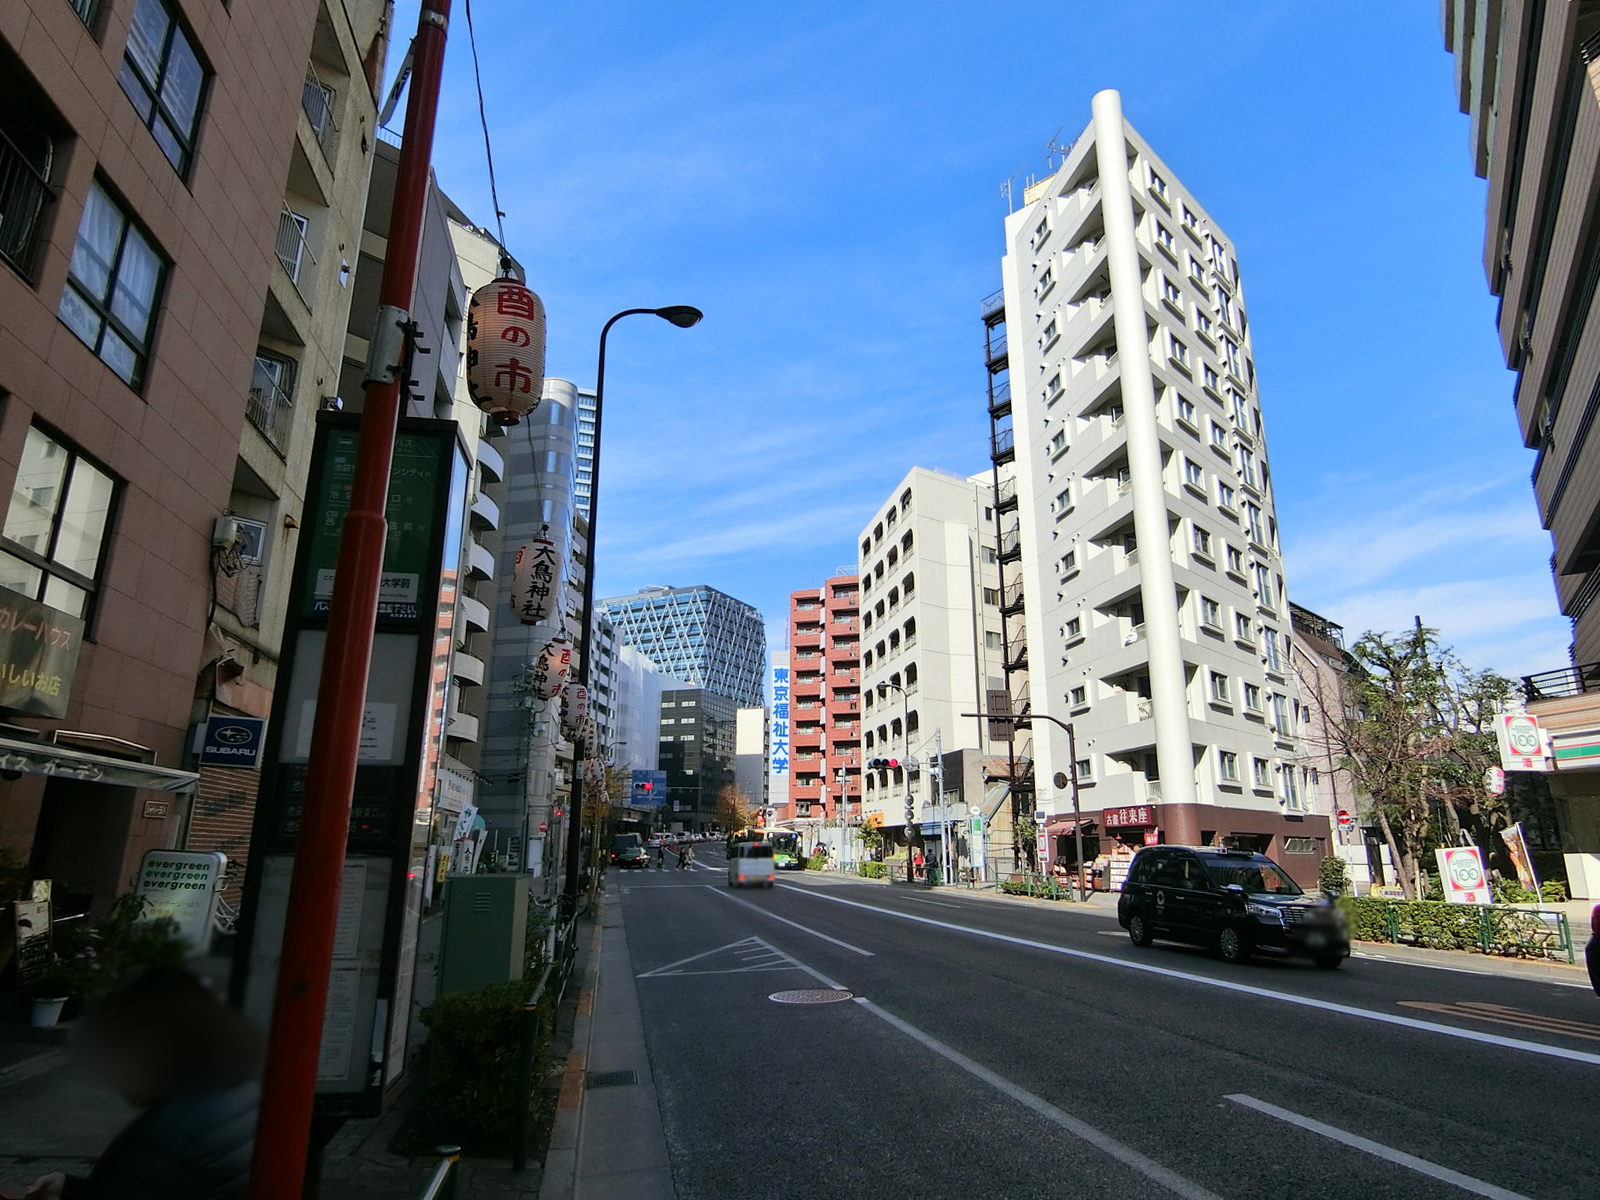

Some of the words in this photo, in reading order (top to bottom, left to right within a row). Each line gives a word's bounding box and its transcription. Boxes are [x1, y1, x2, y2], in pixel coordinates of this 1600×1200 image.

[495, 285, 536, 395] 酉の市
[521, 545, 556, 619] 大鳥神社
[772, 667, 790, 775] 東京福祉大学
[1511, 734, 1537, 747] 100
[204, 745, 257, 757] SUBARU
[148, 860, 210, 871] evergreen
[146, 870, 208, 881] evergreen
[1453, 868, 1479, 882] 100
[143, 880, 206, 890] evergreen
